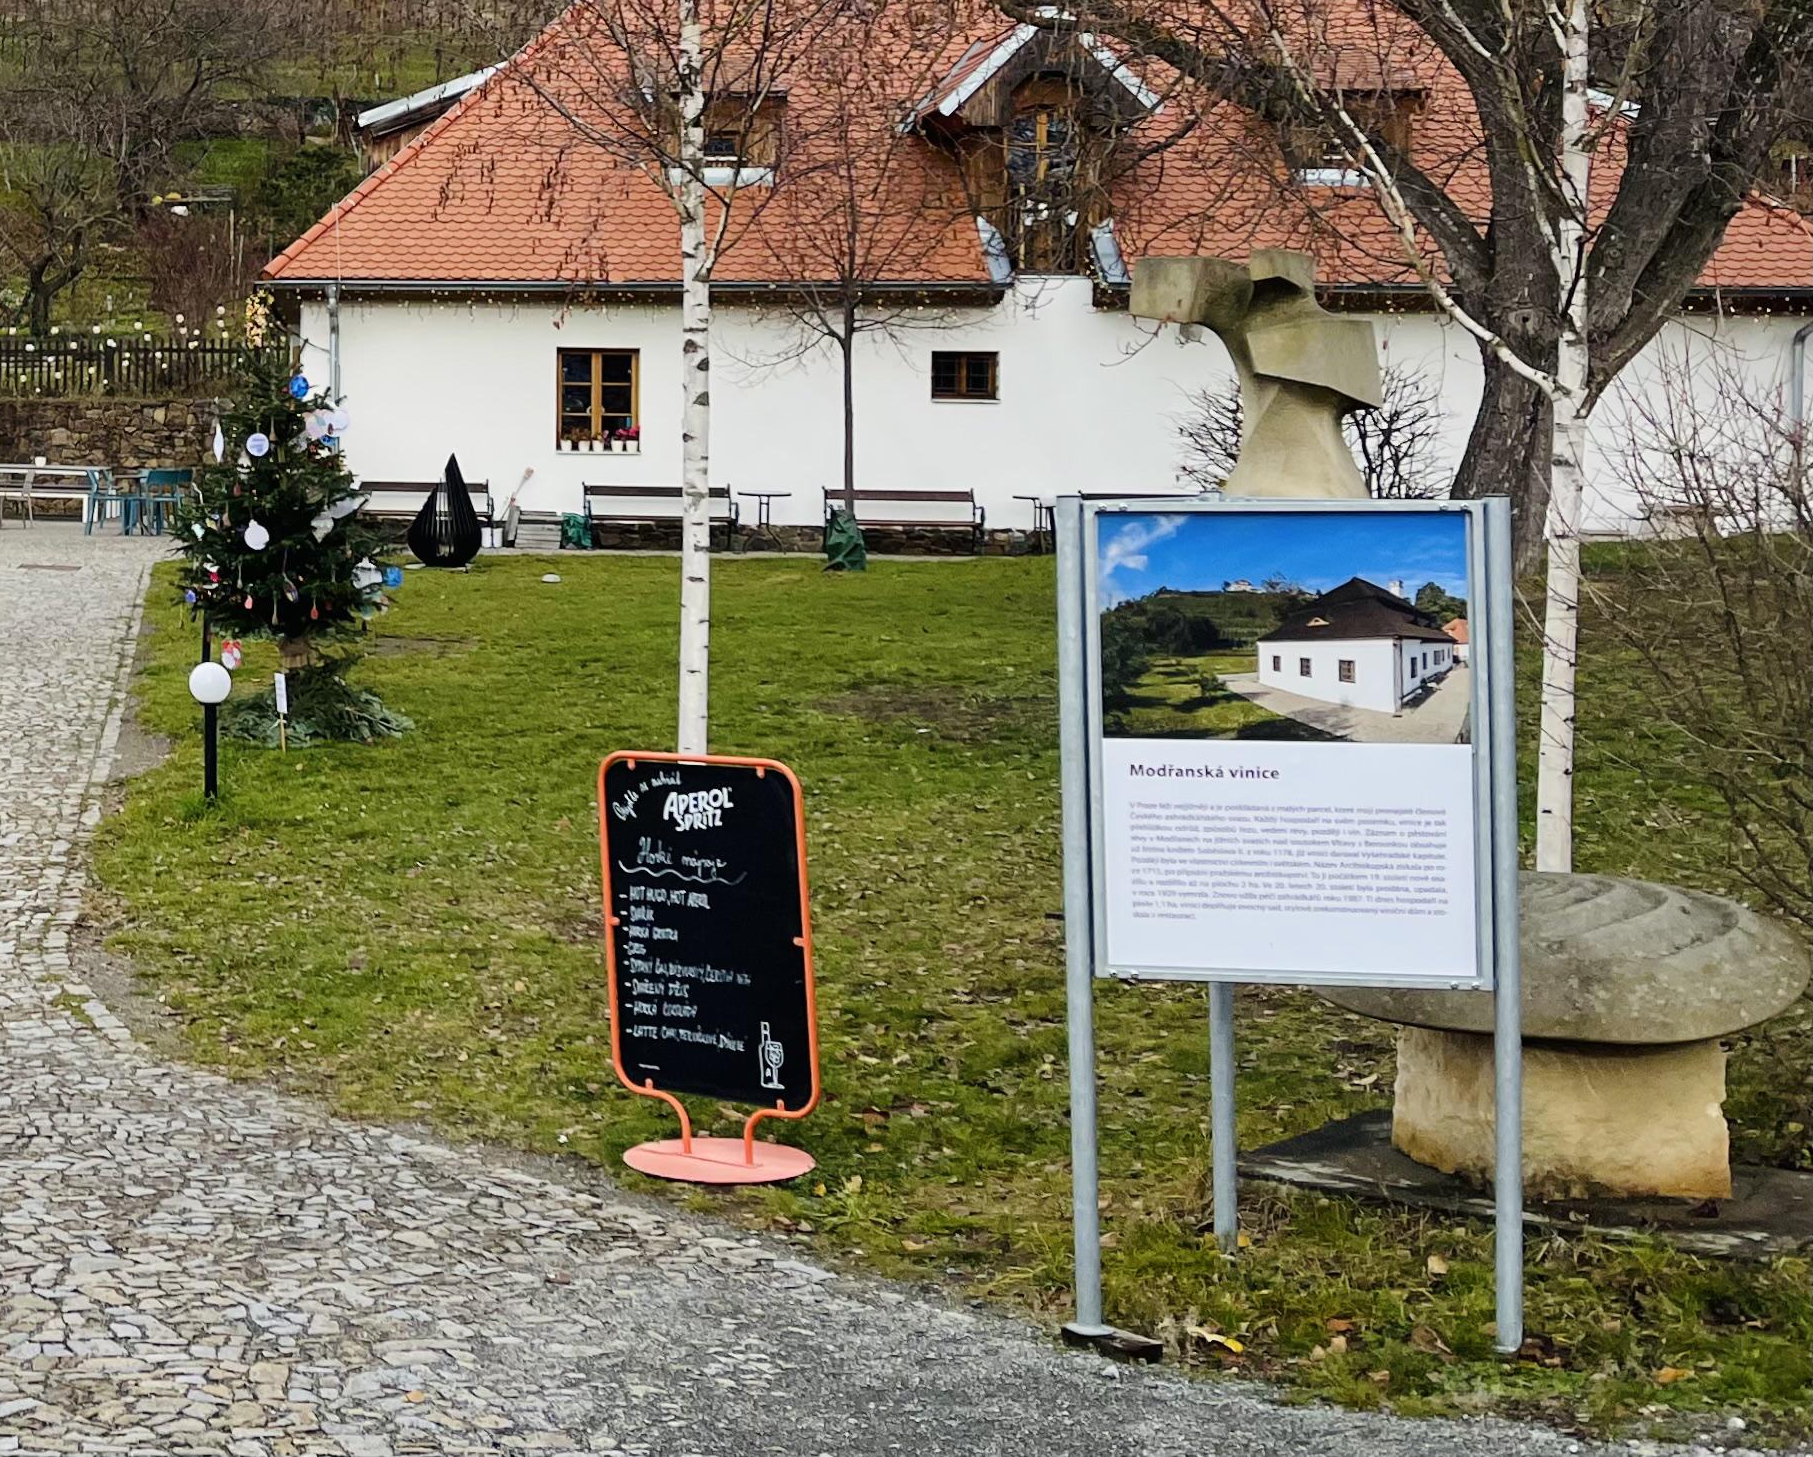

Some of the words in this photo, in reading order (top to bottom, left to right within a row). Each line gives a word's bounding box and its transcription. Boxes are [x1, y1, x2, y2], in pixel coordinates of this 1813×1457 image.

[1129, 764, 1224, 779] Modřanská
[1229, 766, 1280, 780] vinice
[663, 786, 734, 821] APEROL
[675, 808, 723, 832] SPRITZ
